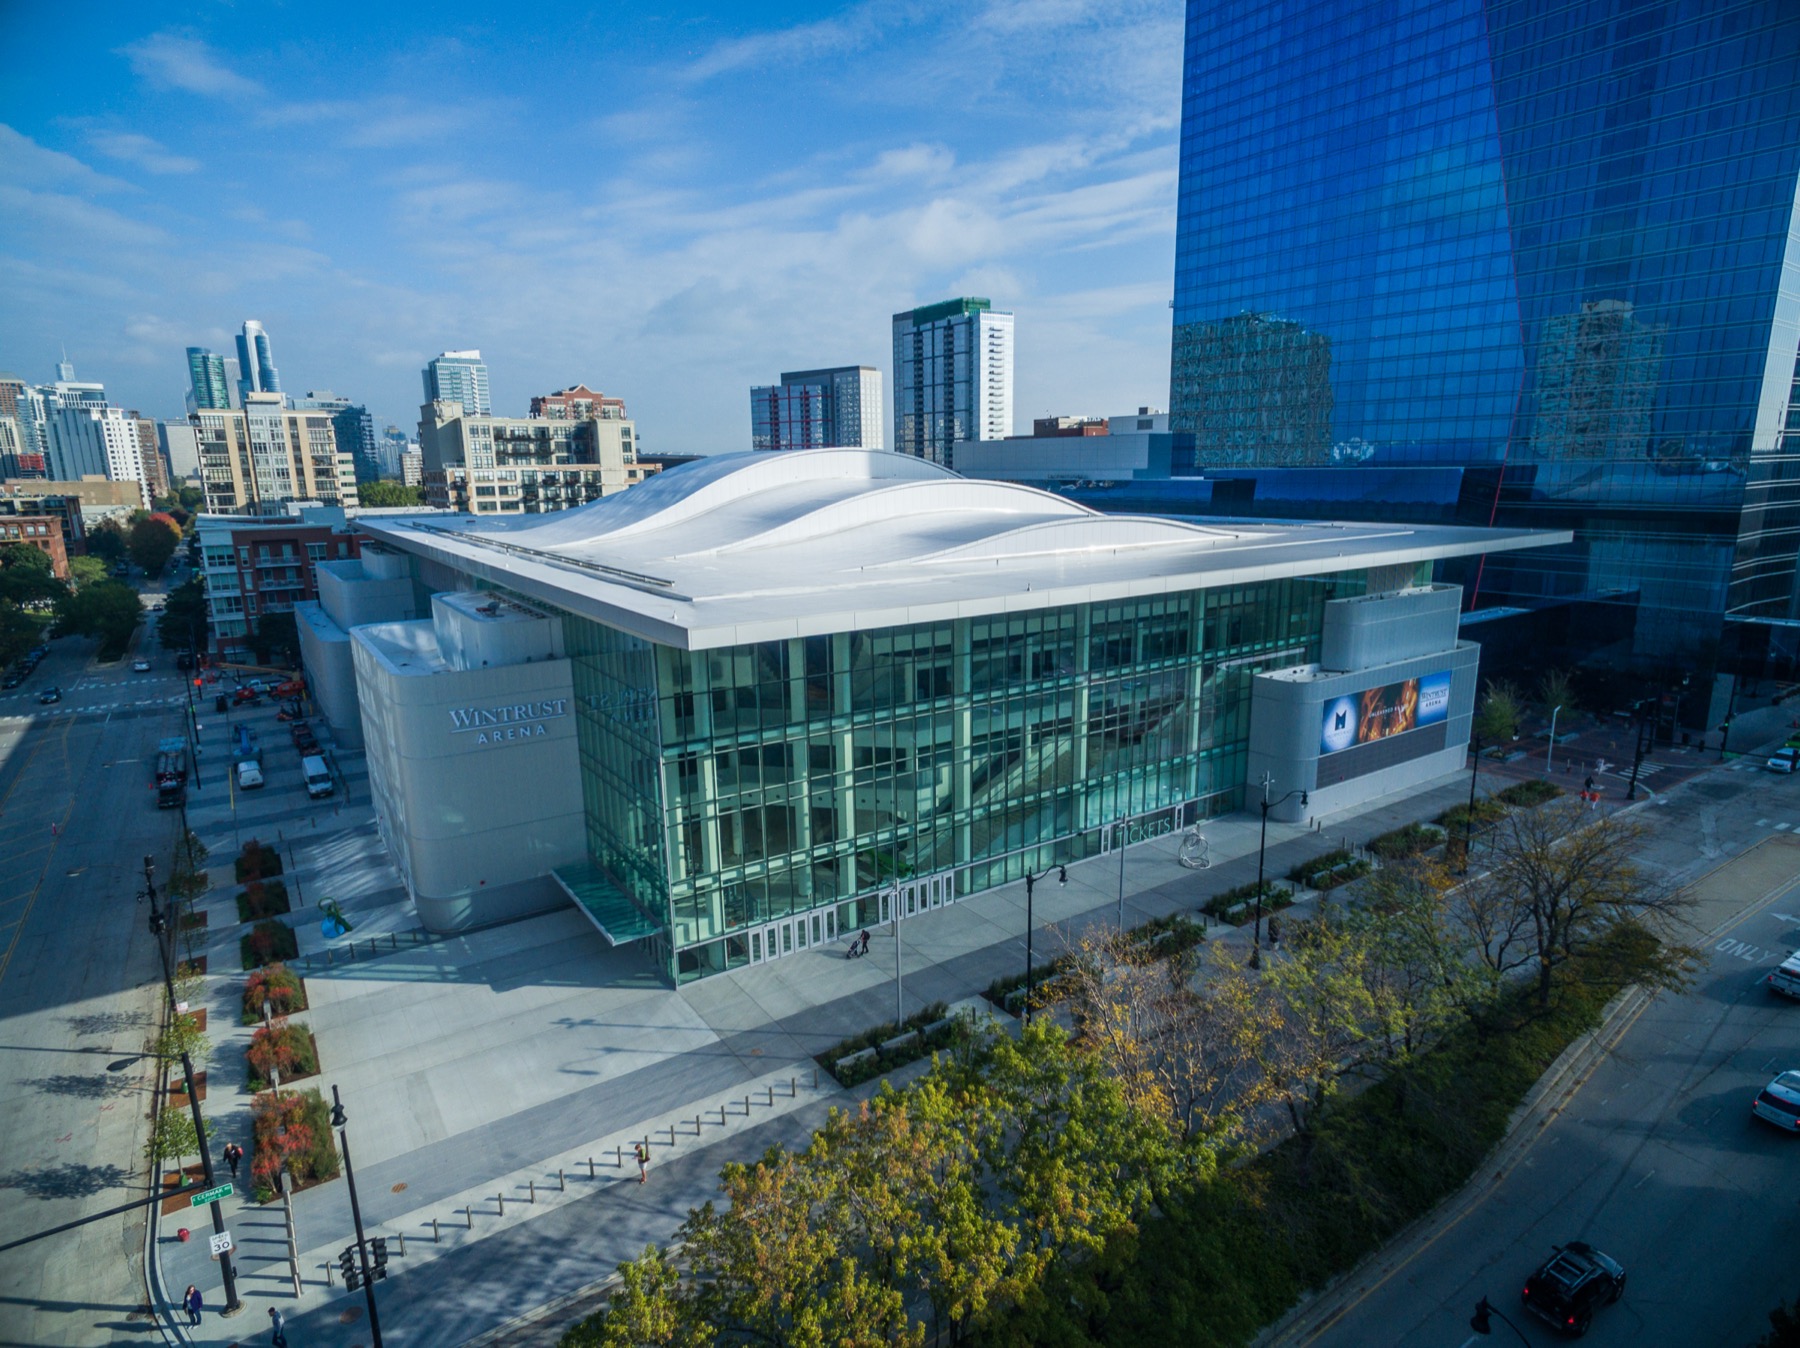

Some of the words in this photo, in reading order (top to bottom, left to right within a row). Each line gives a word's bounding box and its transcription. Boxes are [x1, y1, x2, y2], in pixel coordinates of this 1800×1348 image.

[449, 699, 566, 728] WINTRUST
[478, 724, 546, 744] ARENA
[1116, 817, 1171, 846] TICKETS
[1715, 938, 1778, 964] ONLY
[197, 1187, 223, 1200] CERMAK
[214, 1241, 229, 1251] 30
